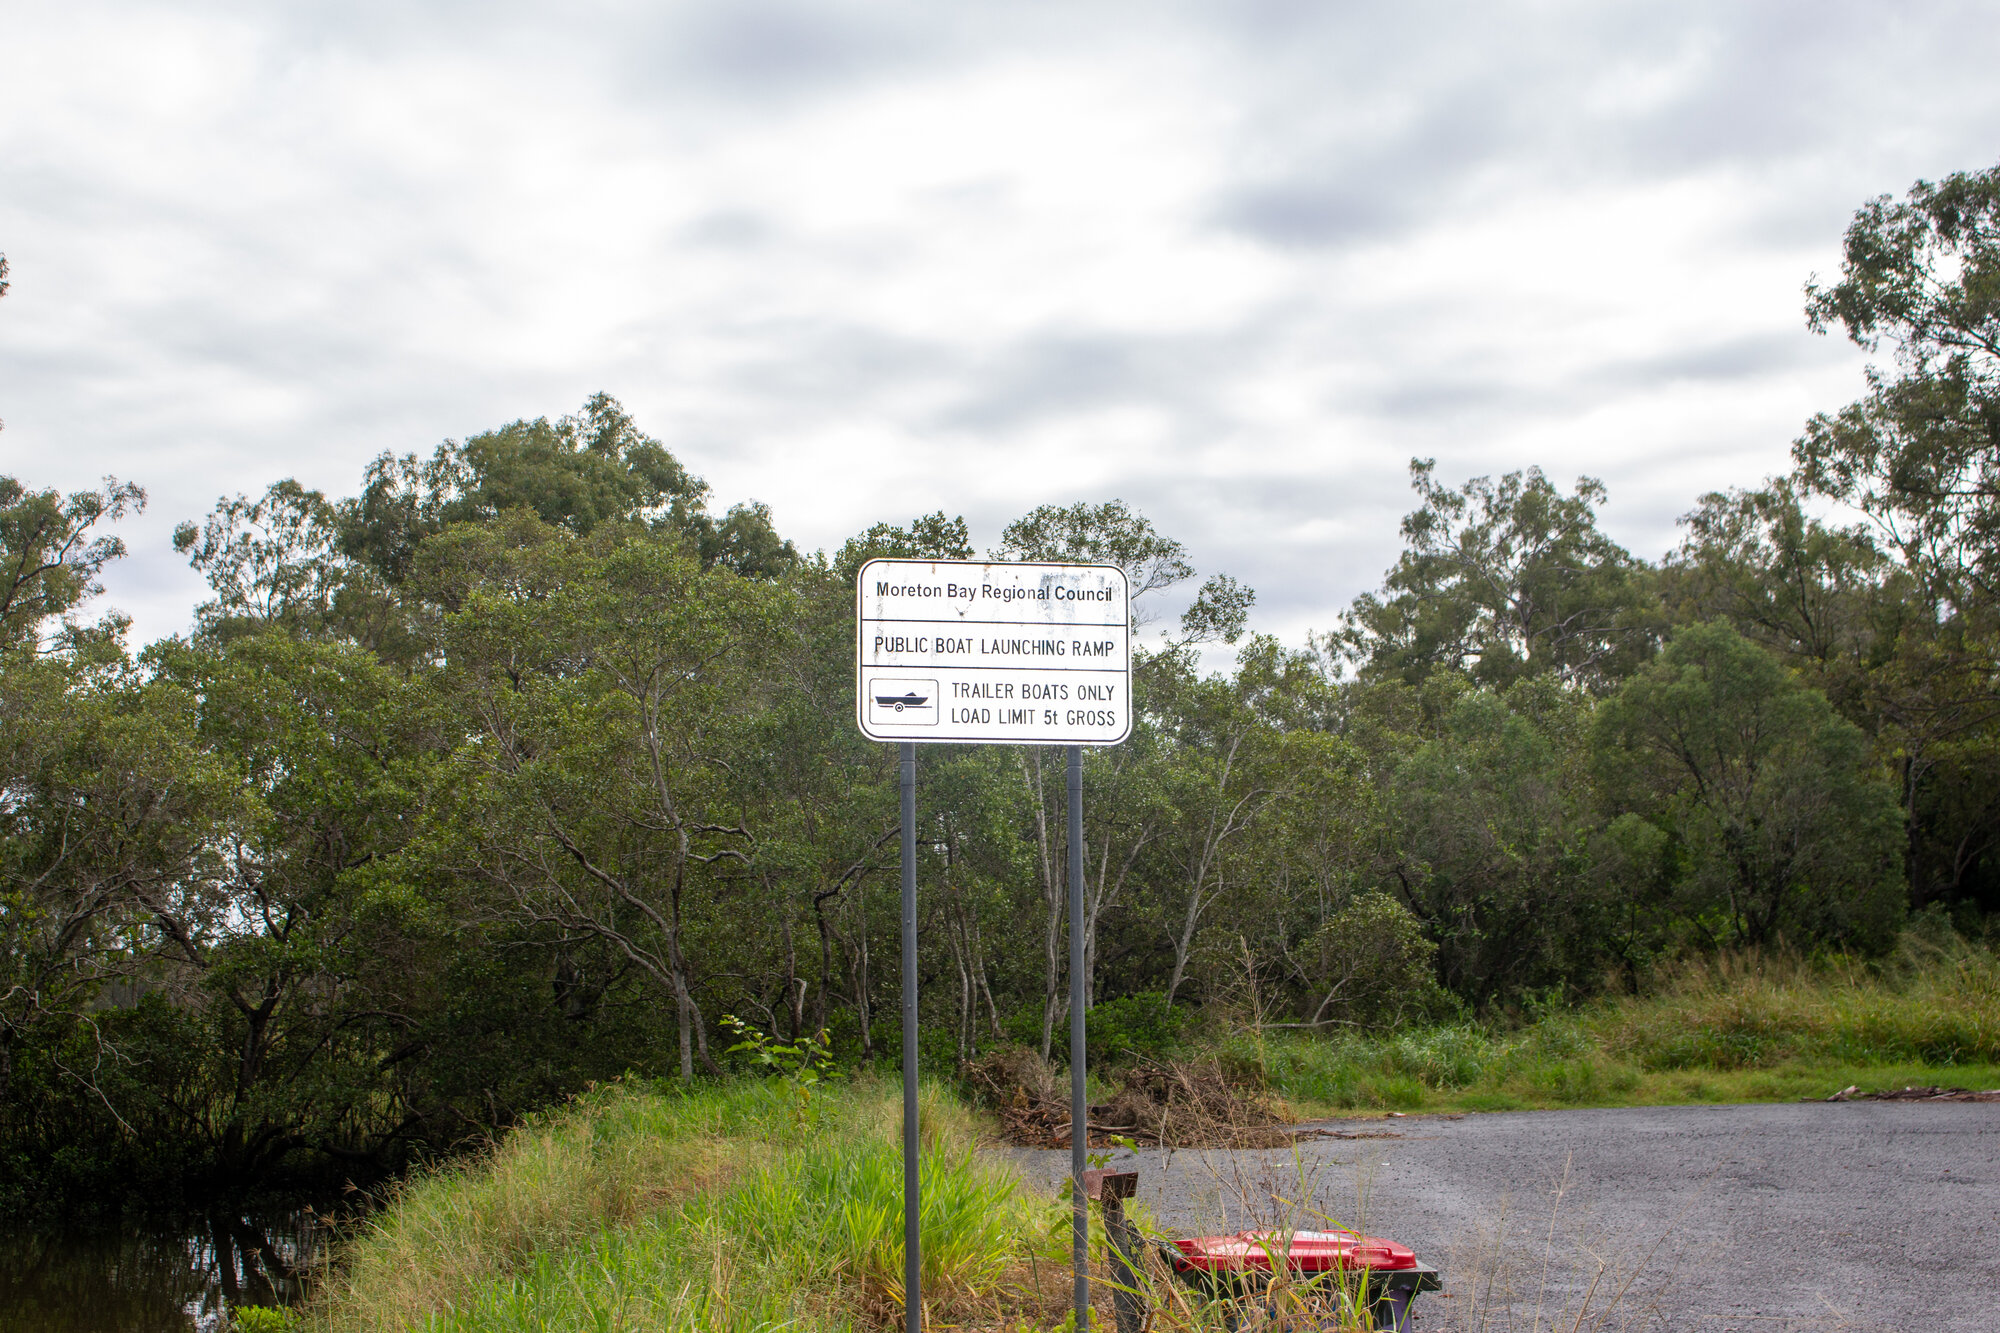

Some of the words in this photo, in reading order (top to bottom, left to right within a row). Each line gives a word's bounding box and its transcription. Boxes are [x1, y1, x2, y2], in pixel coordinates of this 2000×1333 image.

[877, 582, 942, 598] Moreton
[948, 584, 976, 601] Bay
[982, 584, 1049, 602] Regional
[1055, 586, 1112, 601] Council
[875, 637, 928, 653] PUBLIC
[936, 638, 973, 654] BOAT
[982, 639, 1065, 656] LAUNCHING
[1073, 641, 1114, 657] RAMP
[952, 683, 1014, 699] TRAILER
[1022, 684, 1068, 700] BOATS
[1078, 685, 1115, 701] ONLY
[952, 708, 990, 724] LOAD
[999, 709, 1035, 725] LIMIT
[1044, 710, 1058, 725] 5t
[1067, 710, 1115, 726] GROSS
